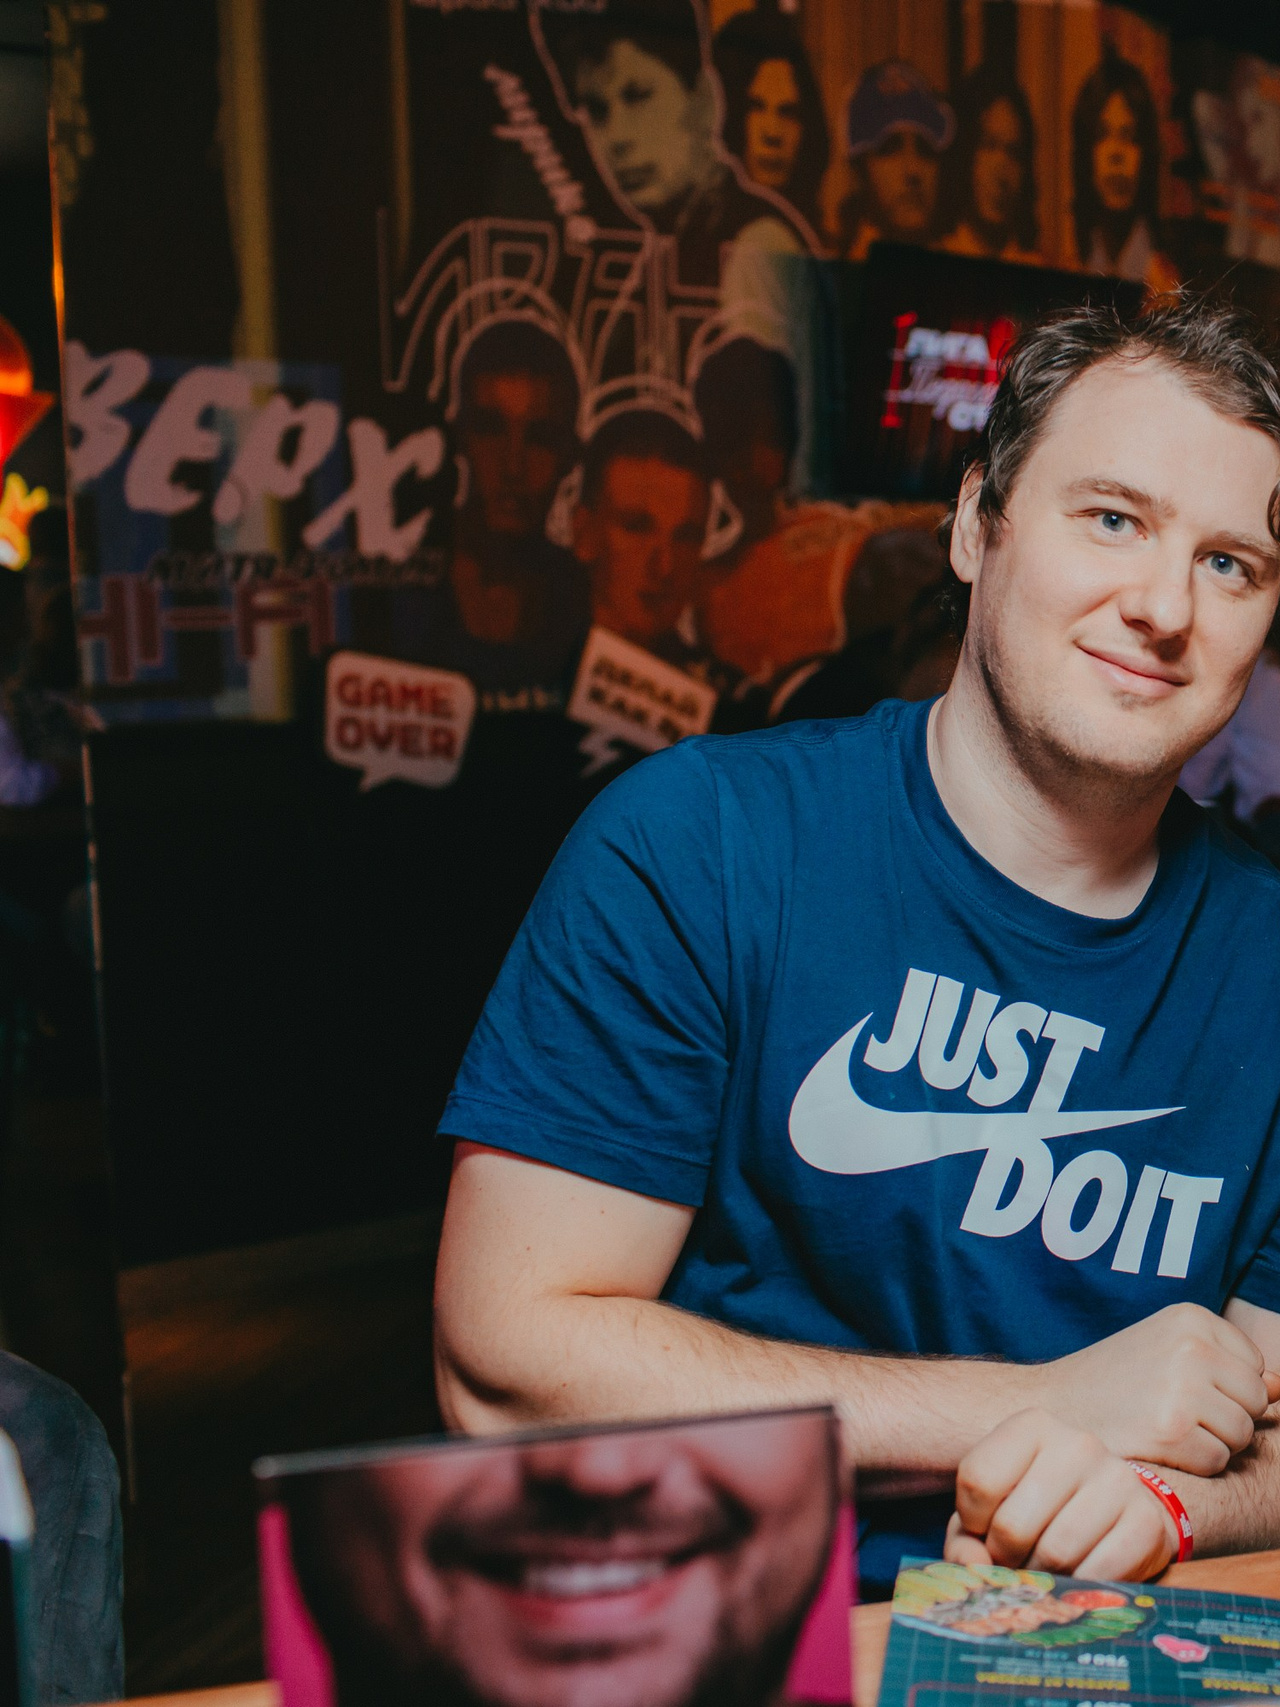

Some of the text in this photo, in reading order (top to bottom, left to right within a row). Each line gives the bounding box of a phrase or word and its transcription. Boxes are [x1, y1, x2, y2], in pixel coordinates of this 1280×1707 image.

[337, 673, 454, 719] GAME
[336, 715, 456, 761] OVER
[863, 968, 1106, 1113] JUST
